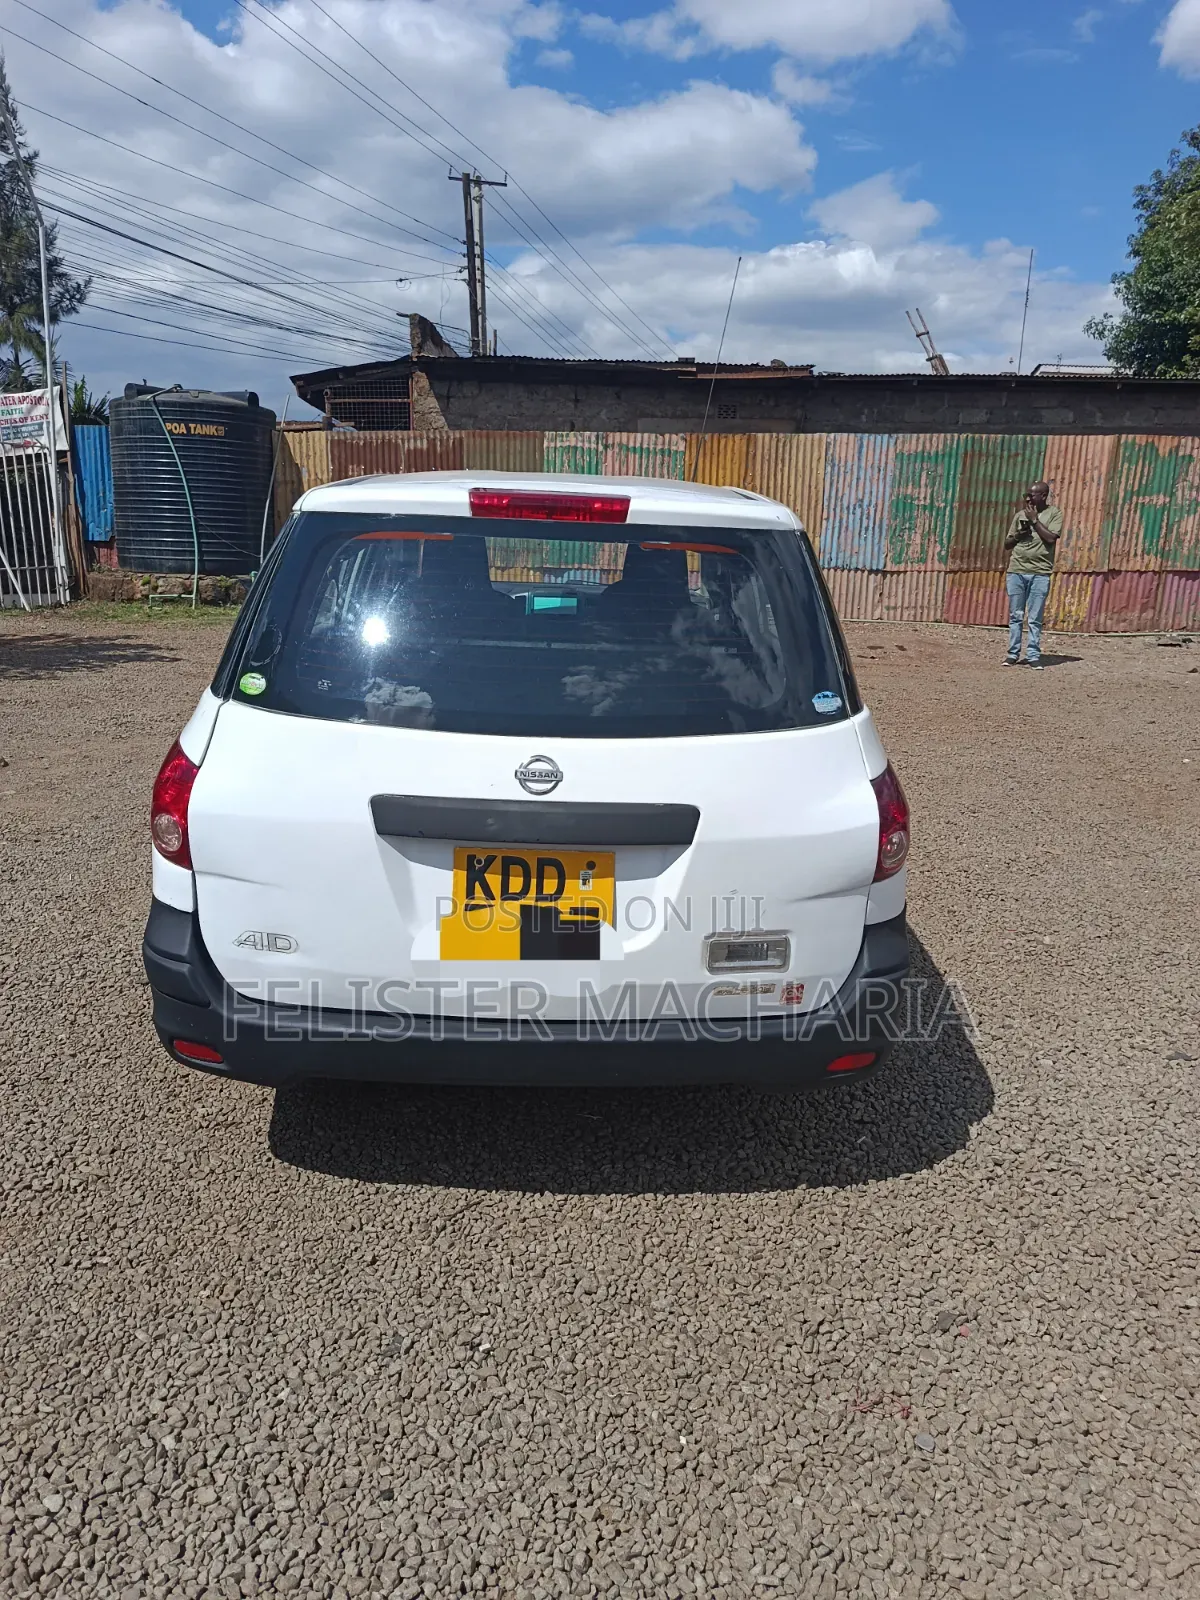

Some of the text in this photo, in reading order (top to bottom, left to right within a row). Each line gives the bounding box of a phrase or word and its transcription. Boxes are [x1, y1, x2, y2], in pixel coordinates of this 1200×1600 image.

[1, 408, 24, 416] FAITH
[165, 422, 187, 434] POA
[519, 770, 558, 779] NISSAN
[465, 854, 566, 902] KDD
[231, 930, 299, 954] AD
